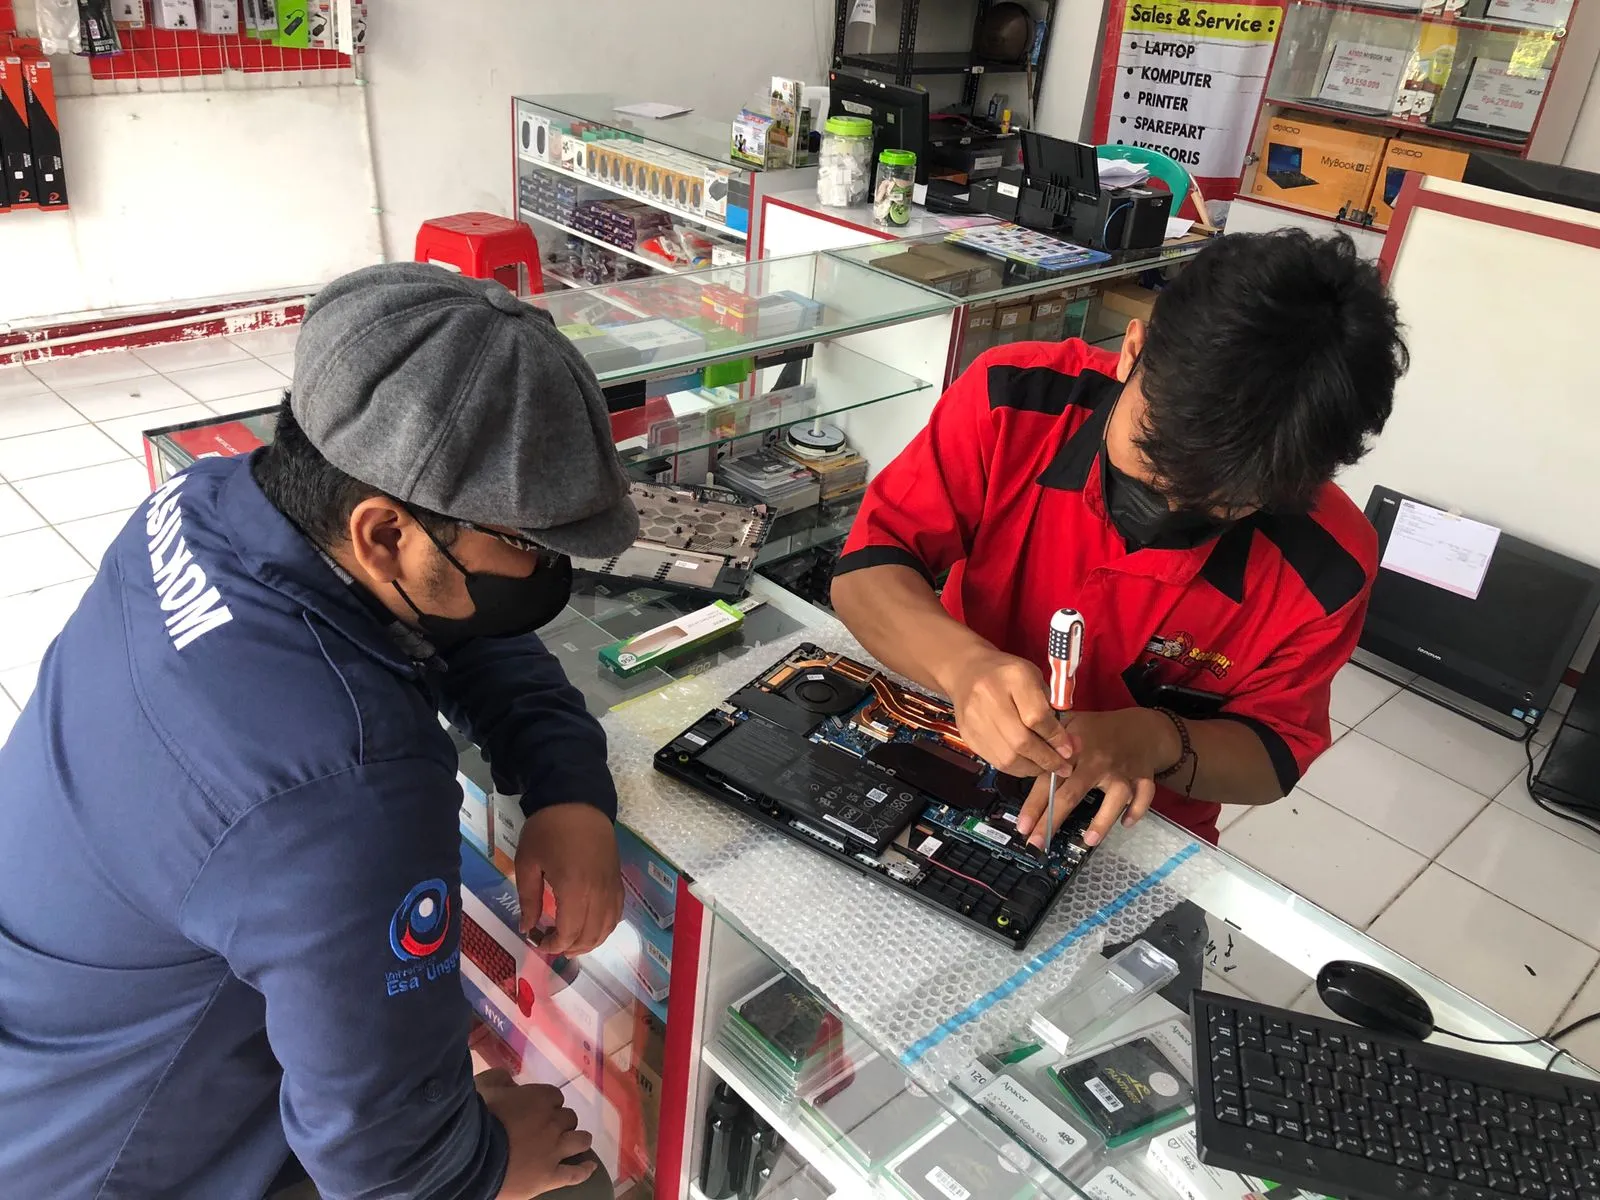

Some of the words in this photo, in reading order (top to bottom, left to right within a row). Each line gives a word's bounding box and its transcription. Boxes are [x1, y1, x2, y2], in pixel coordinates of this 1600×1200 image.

[1131, 4, 1173, 25] Sales
[1177, 8, 1191, 27] &
[1194, 9, 1262, 33] Service
[1144, 40, 1195, 60] LAPTOP
[1140, 65, 1212, 89] KOMPUTER
[1137, 91, 1189, 112] PRINTER
[1133, 115, 1206, 141] SPAREPART
[1320, 155, 1357, 172] MyBook
[144, 472, 234, 652] ASILKOM
[1417, 646, 1442, 661] lenovo
[496, 891, 522, 917] NYK
[386, 975, 420, 996] Esa
[426, 949, 460, 981] Unggu
[483, 1003, 506, 1033] NYK
[1000, 1081, 1030, 1104] Apacer
[1104, 1065, 1142, 1105] PANTHER
[999, 1100, 1015, 1118] SATA
[1035, 1130, 1049, 1144] SSD
[1057, 1130, 1076, 1146] 480
[1105, 1173, 1137, 1198] Apacer
